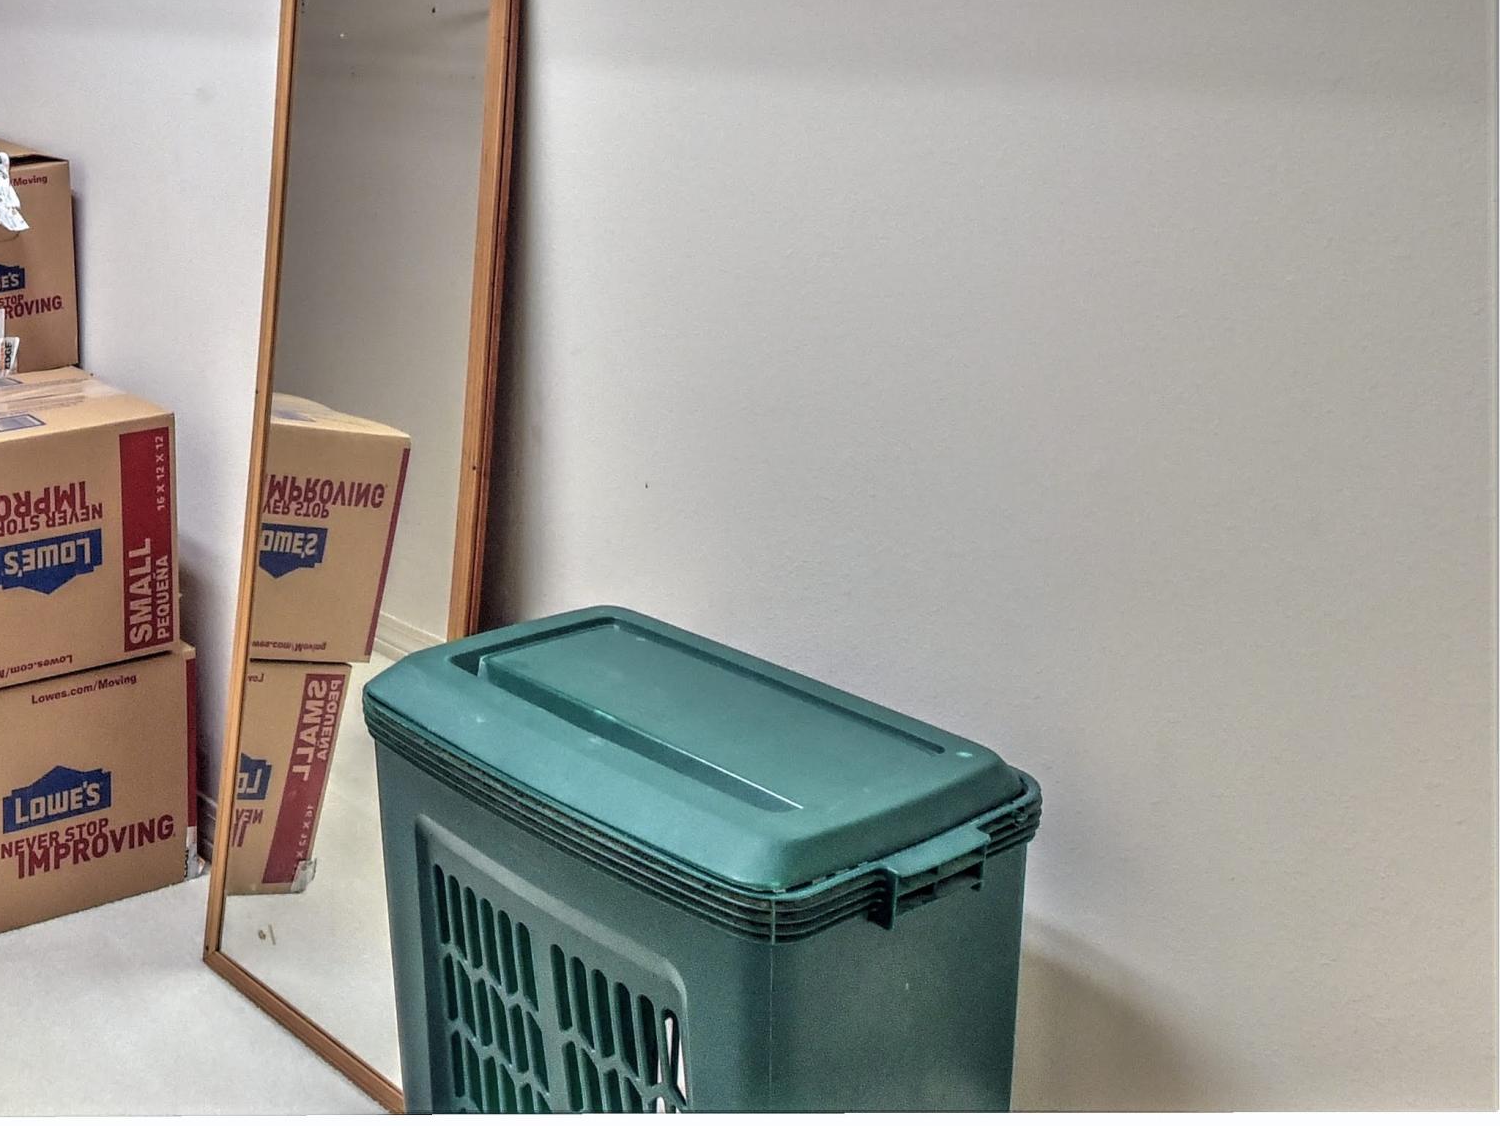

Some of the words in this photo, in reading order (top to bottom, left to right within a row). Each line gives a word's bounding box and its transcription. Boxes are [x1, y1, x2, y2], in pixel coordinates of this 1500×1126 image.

[5, 296, 62, 319] ROVING
[155, 436, 163, 449] 12
[156, 466, 165, 480] 12
[46, 503, 103, 527] NEVER
[156, 497, 165, 511] 16
[3, 537, 90, 577] LOWE'S
[129, 538, 152, 644] SMALL
[152, 555, 169, 639] PEQUEÑA
[32, 675, 137, 704] Lowes.com/Moving
[15, 781, 100, 824] LOWE'S
[1, 831, 59, 859] NEVER
[66, 818, 109, 842] STOP
[18, 815, 174, 879] IMPROVING
